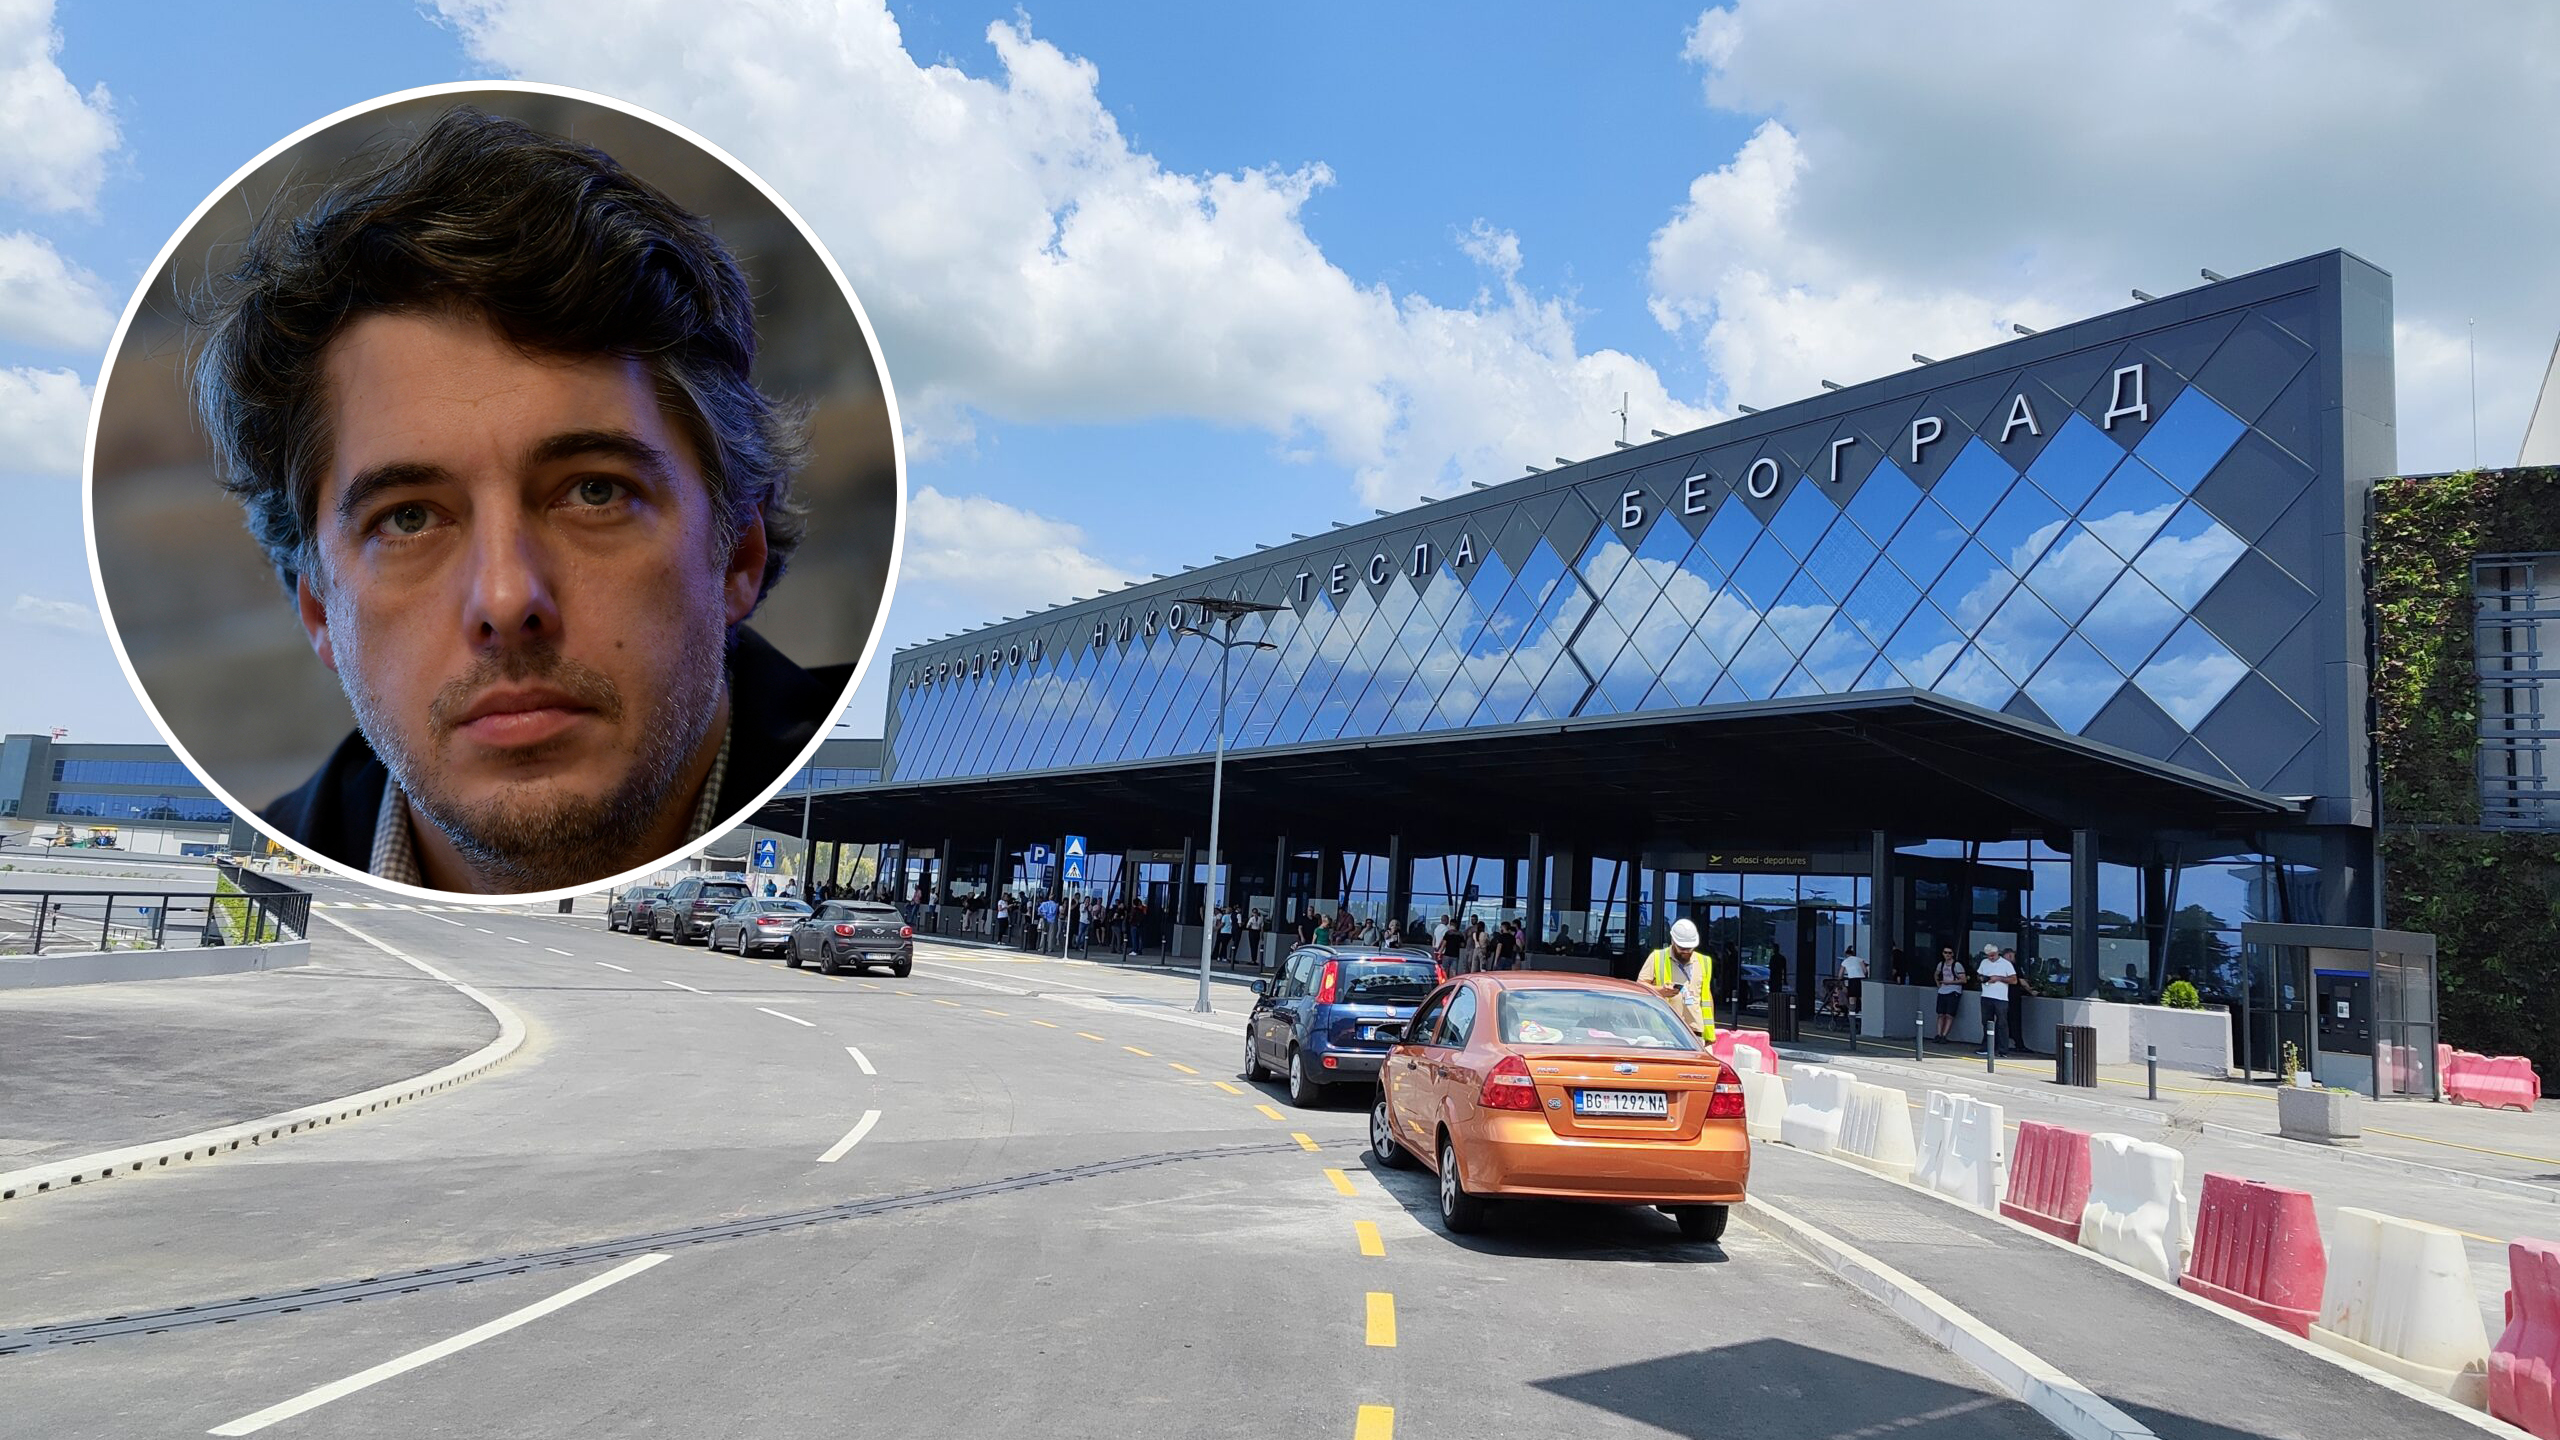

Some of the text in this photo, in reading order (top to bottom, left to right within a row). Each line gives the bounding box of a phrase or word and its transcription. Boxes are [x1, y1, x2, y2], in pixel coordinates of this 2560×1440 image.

[908, 639, 1041, 689] АЕРОДРОМ
[1296, 533, 1477, 601] ТЕСЛА
[1621, 363, 2149, 529] БЕОГРАД
[1034, 847, 1044, 861] P
[1764, 856, 1807, 866] departures
[1585, 1093, 1602, 1109] BG
